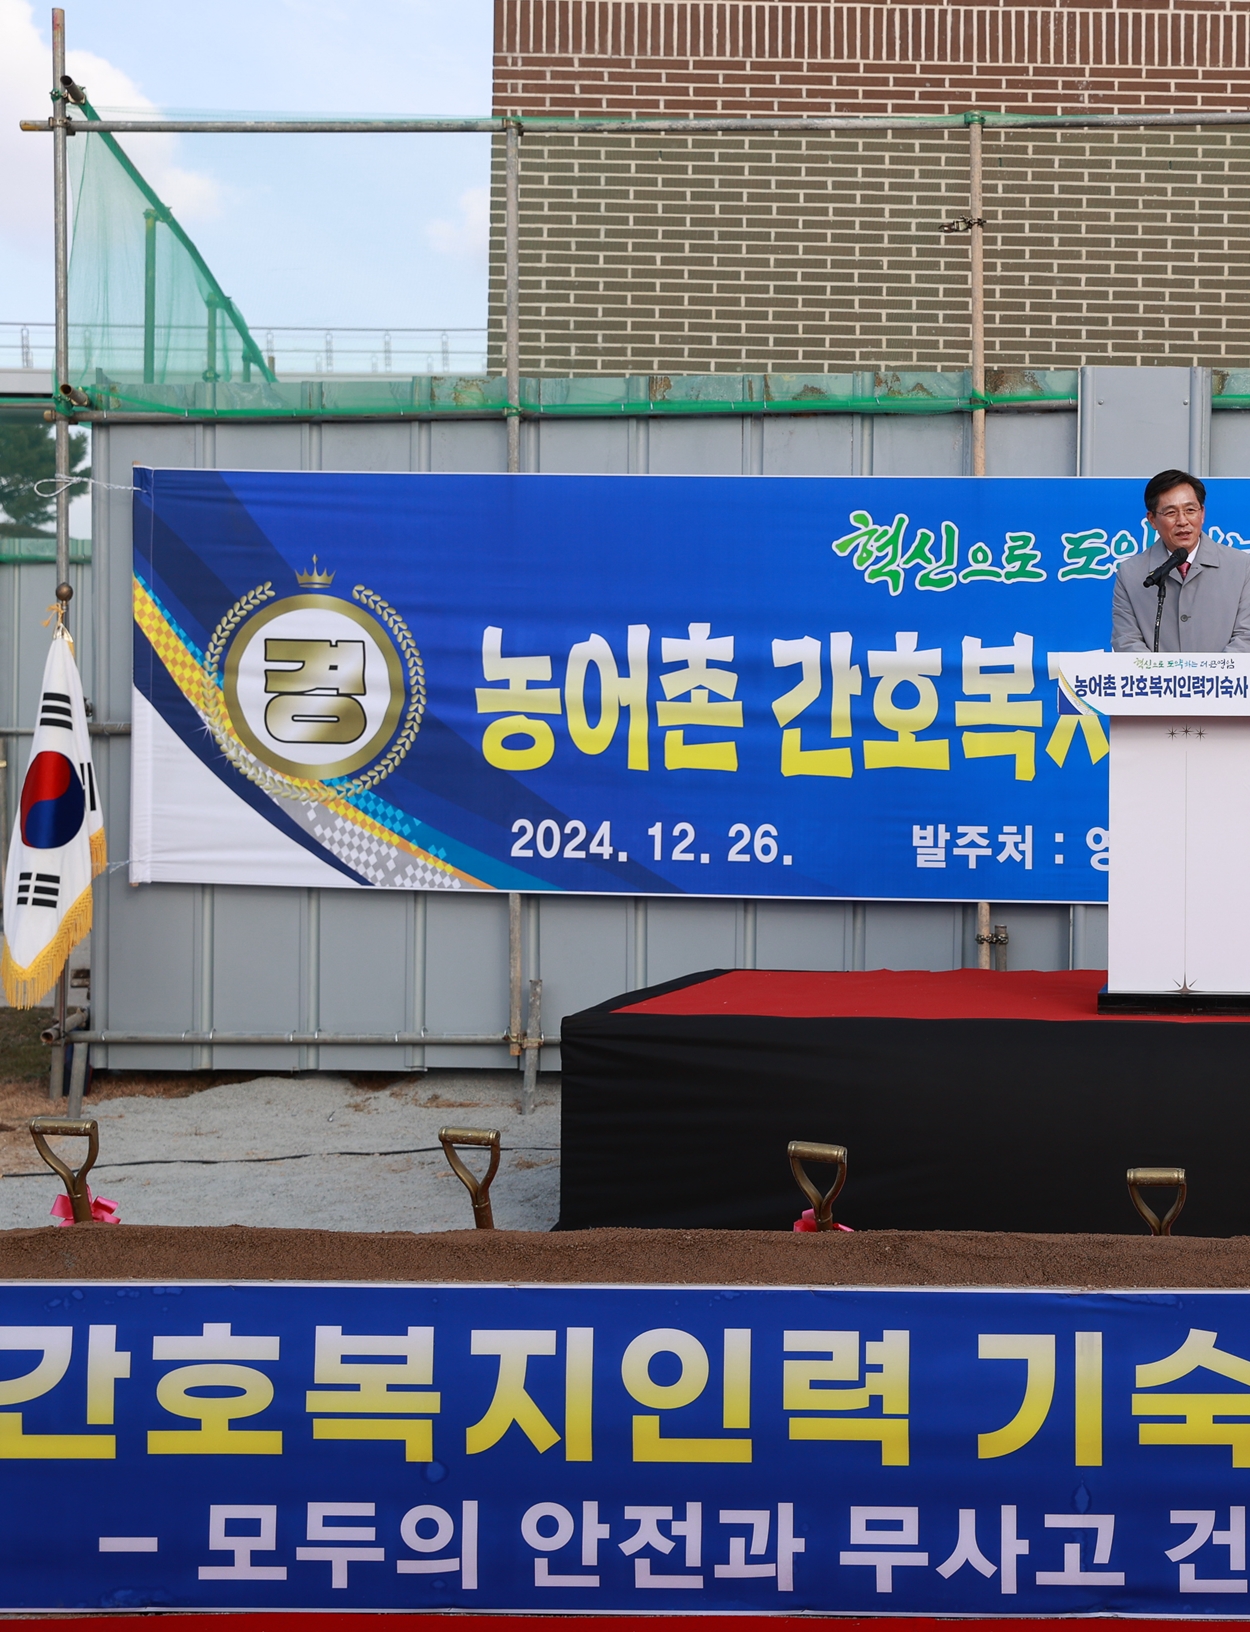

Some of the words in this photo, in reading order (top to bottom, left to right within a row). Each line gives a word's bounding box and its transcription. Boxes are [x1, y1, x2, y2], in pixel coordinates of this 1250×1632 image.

[832, 510, 1047, 596] 혁신으로
[264, 638, 367, 744] 경
[475, 622, 744, 772] 농어촌
[1074, 674, 1117, 697] 농어촌
[1120, 675, 1248, 698] 간호복지인력기숙사
[1134, 657, 1164, 669] 혁신으로
[511, 819, 628, 862] 2024.
[648, 821, 710, 864] 12.
[728, 823, 793, 866] 26.
[912, 824, 1034, 870] 발주처
[0, 1322, 912, 1467] 간호복지인력
[198, 1500, 479, 1590] 모두의
[520, 1501, 805, 1592] 안전과
[838, 1505, 1126, 1595] 무사고
